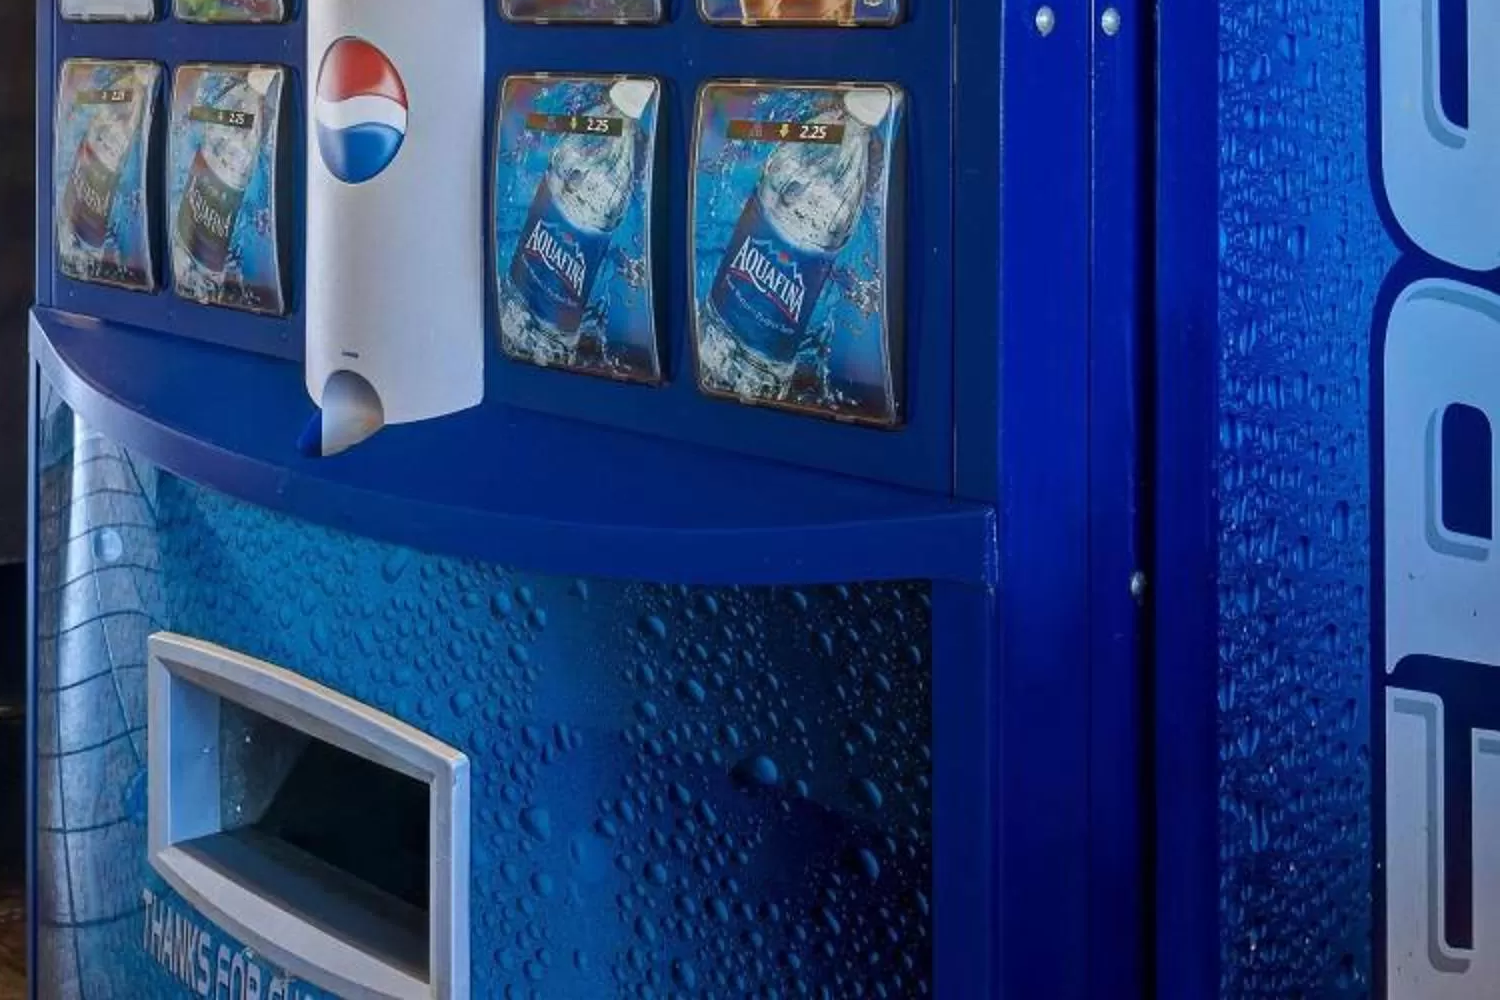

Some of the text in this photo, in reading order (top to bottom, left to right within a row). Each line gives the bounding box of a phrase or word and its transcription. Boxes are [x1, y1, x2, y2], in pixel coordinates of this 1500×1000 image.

[586, 117, 609, 133] 2.25
[799, 124, 828, 140] 2.25
[524, 219, 586, 297] AQUAFINA
[730, 235, 804, 323] AQUAFINA
[142, 887, 212, 997] THANKS
